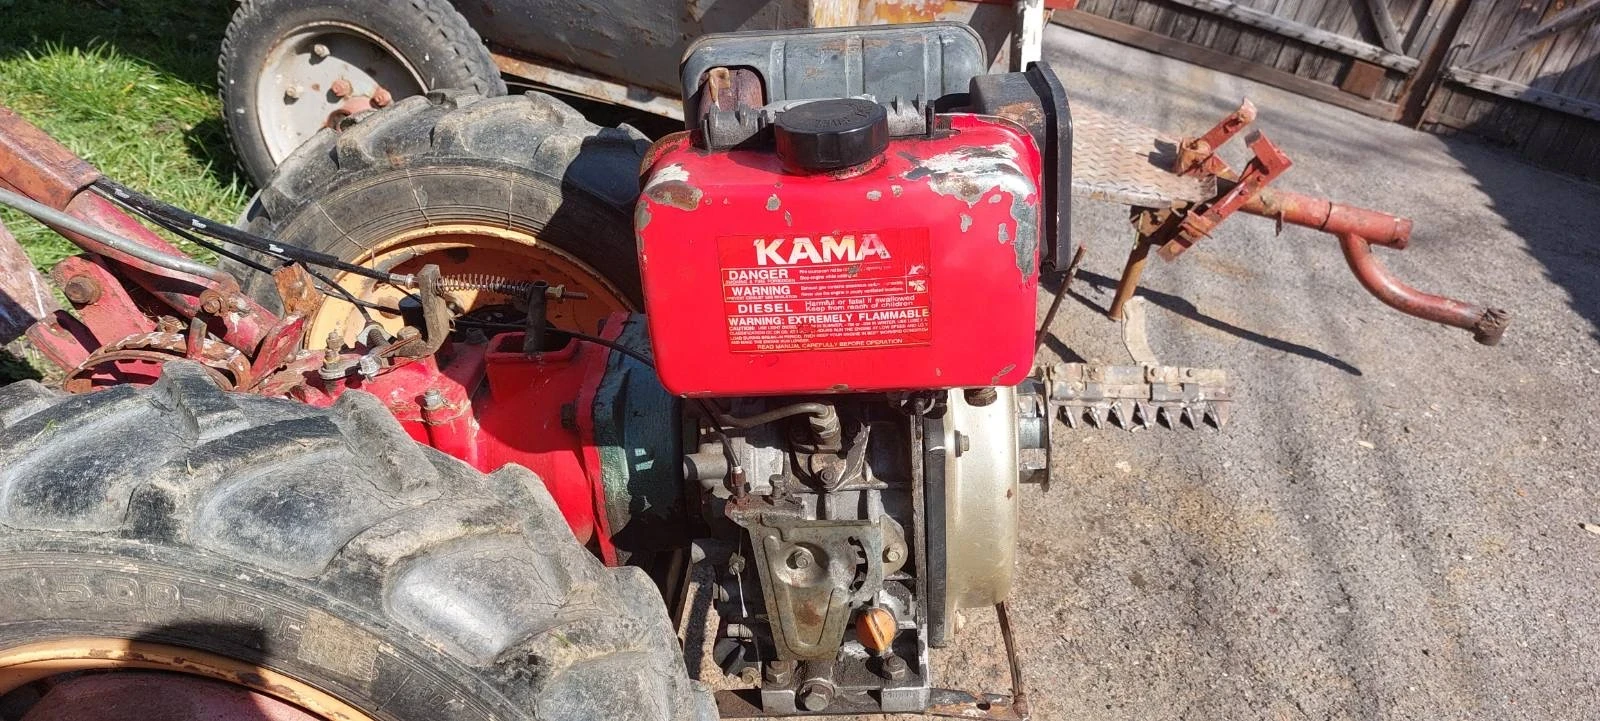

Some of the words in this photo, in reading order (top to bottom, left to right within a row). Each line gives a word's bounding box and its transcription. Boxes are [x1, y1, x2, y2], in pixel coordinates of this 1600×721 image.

[753, 233, 891, 265] KAMA
[729, 269, 788, 280] DANGER
[732, 285, 790, 296] WARNING
[805, 299, 835, 307] Harmful
[875, 295, 915, 303] swallowed
[882, 300, 913, 308] children
[738, 303, 793, 313] DIESEL
[728, 316, 785, 326] WARNING:
[788, 313, 852, 325] EXTREMELY
[859, 309, 929, 322] FLAMMABLE
